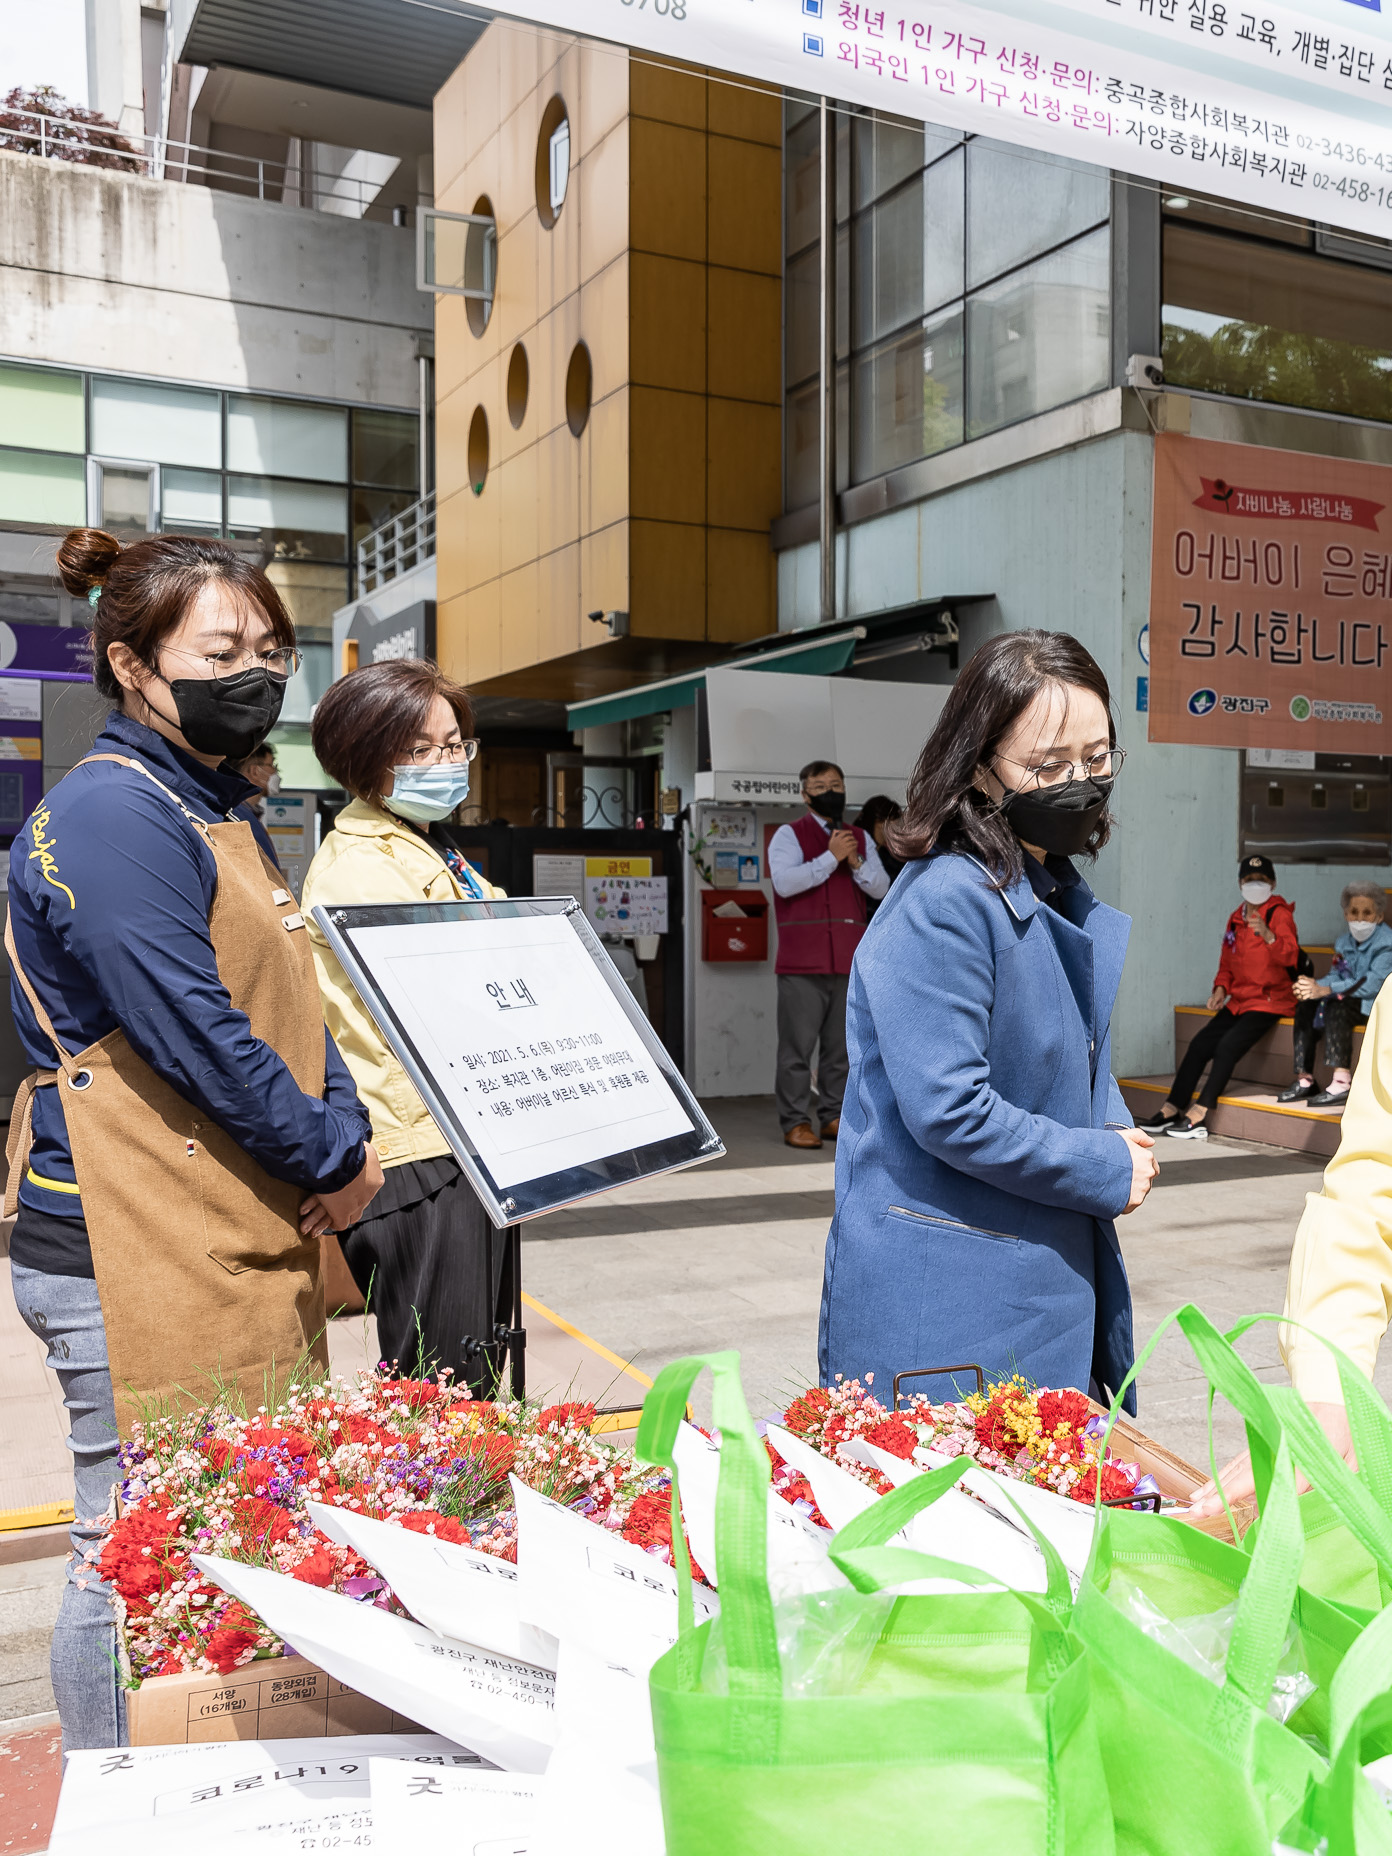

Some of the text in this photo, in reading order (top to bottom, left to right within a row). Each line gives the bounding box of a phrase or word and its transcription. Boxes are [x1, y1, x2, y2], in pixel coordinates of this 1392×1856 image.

[1188, 0, 1228, 37] 실용
[1236, 13, 1281, 56] 교육,
[837, 1, 885, 38] 청년
[897, 19, 932, 51] 1인
[942, 31, 988, 64] 가구
[996, 46, 1100, 95] 신청·문의:
[1104, 77, 1290, 148] 중곡종합사회복지관
[837, 41, 909, 83] 외국인
[921, 65, 956, 95] 1인
[966, 77, 1010, 108] 가구
[1019, 91, 1120, 137] 신청·문의:
[1125, 119, 1307, 188] 자양종합사회복지관
[1236, 492, 1353, 521] 자비나눔, 사랑나눔
[1173, 530, 1301, 589] 어버이
[1180, 602, 1389, 668] 감사합니다
[1221, 696, 1271, 715] 광진구
[462, 1054, 488, 1070] 일시:
[476, 1078, 501, 1094] 장소:
[501, 1072, 531, 1089] 복지관
[550, 1059, 584, 1078] 어린이집
[490, 1101, 515, 1118] 내용:
[515, 1091, 552, 1112] 어버이날
[551, 1086, 580, 1104] 어르신
[579, 1081, 598, 1097] 특식
[430, 1644, 478, 1662] 광진구
[212, 1689, 237, 1701] 서양
[271, 1676, 318, 1691] 동양외겹
[271, 1687, 317, 1704] (28개입)
[200, 1699, 247, 1716] (16개입)
[190, 1764, 359, 1804] 코로나19
